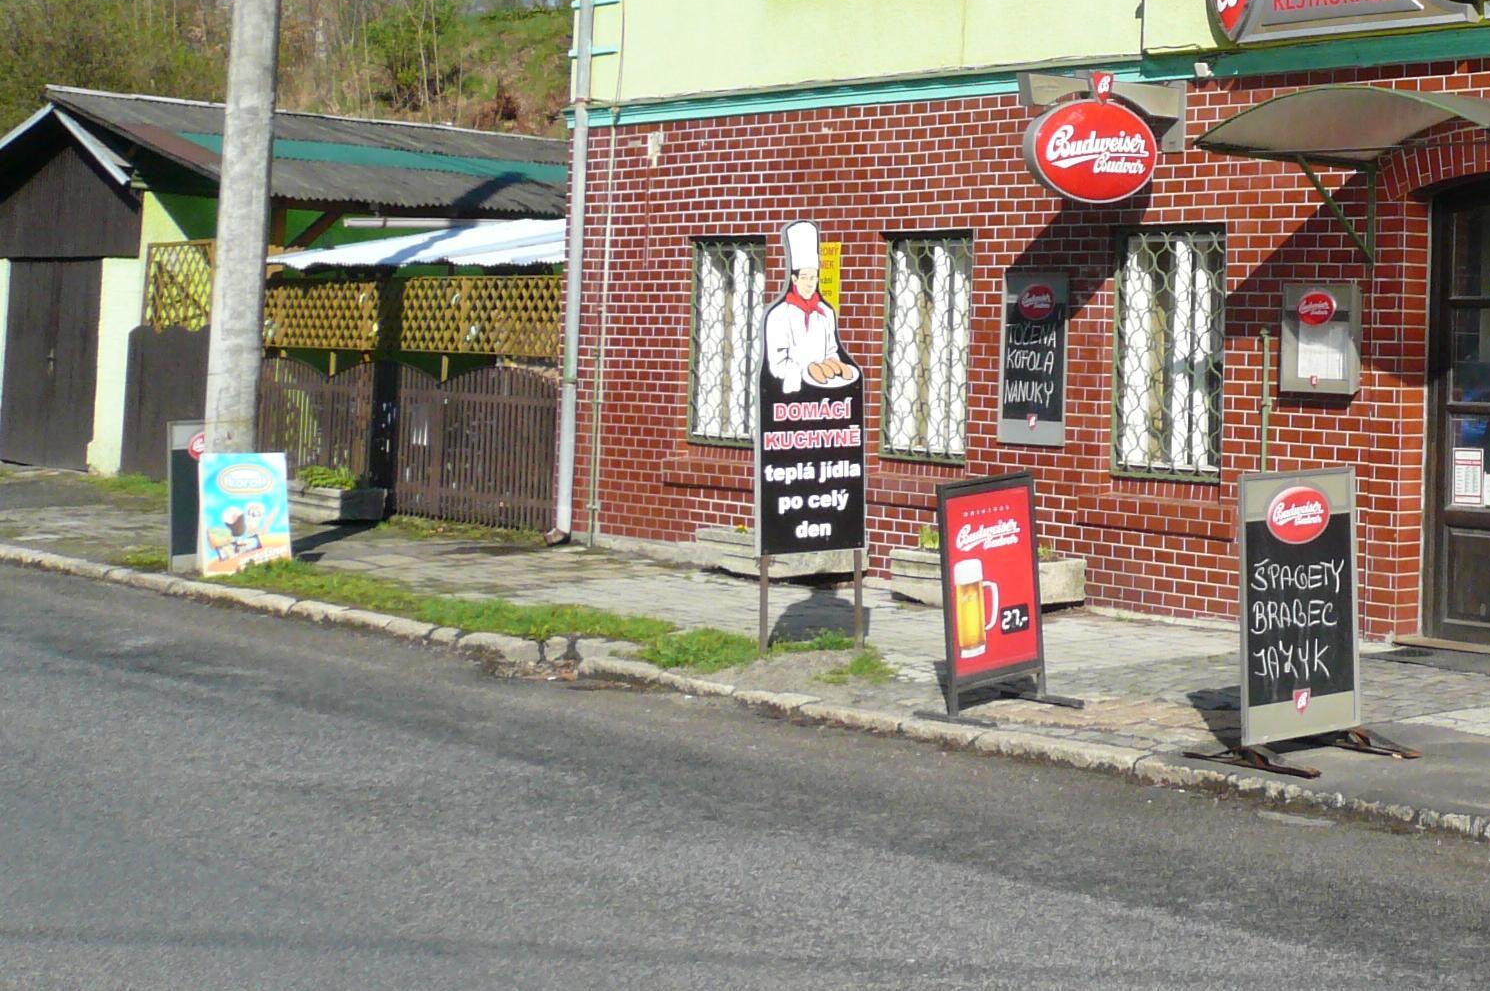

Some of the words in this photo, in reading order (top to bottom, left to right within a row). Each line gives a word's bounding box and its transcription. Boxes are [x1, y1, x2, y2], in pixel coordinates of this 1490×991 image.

[1046, 124, 1149, 166] Budweiser
[1092, 154, 1146, 174] Budvar
[1006, 348, 1054, 375] KOFOLA
[1004, 379, 1054, 409] NANUKY
[773, 397, 852, 421] DOMÁCÍ
[764, 425, 861, 450] KUCHYNĚ
[764, 462, 815, 485] teplá
[819, 460, 861, 483] jídla
[778, 495, 803, 514] po
[808, 489, 849, 511] celý
[1272, 500, 1324, 525] Budweiser
[795, 520, 832, 539] den
[956, 519, 1020, 551] Budweiser
